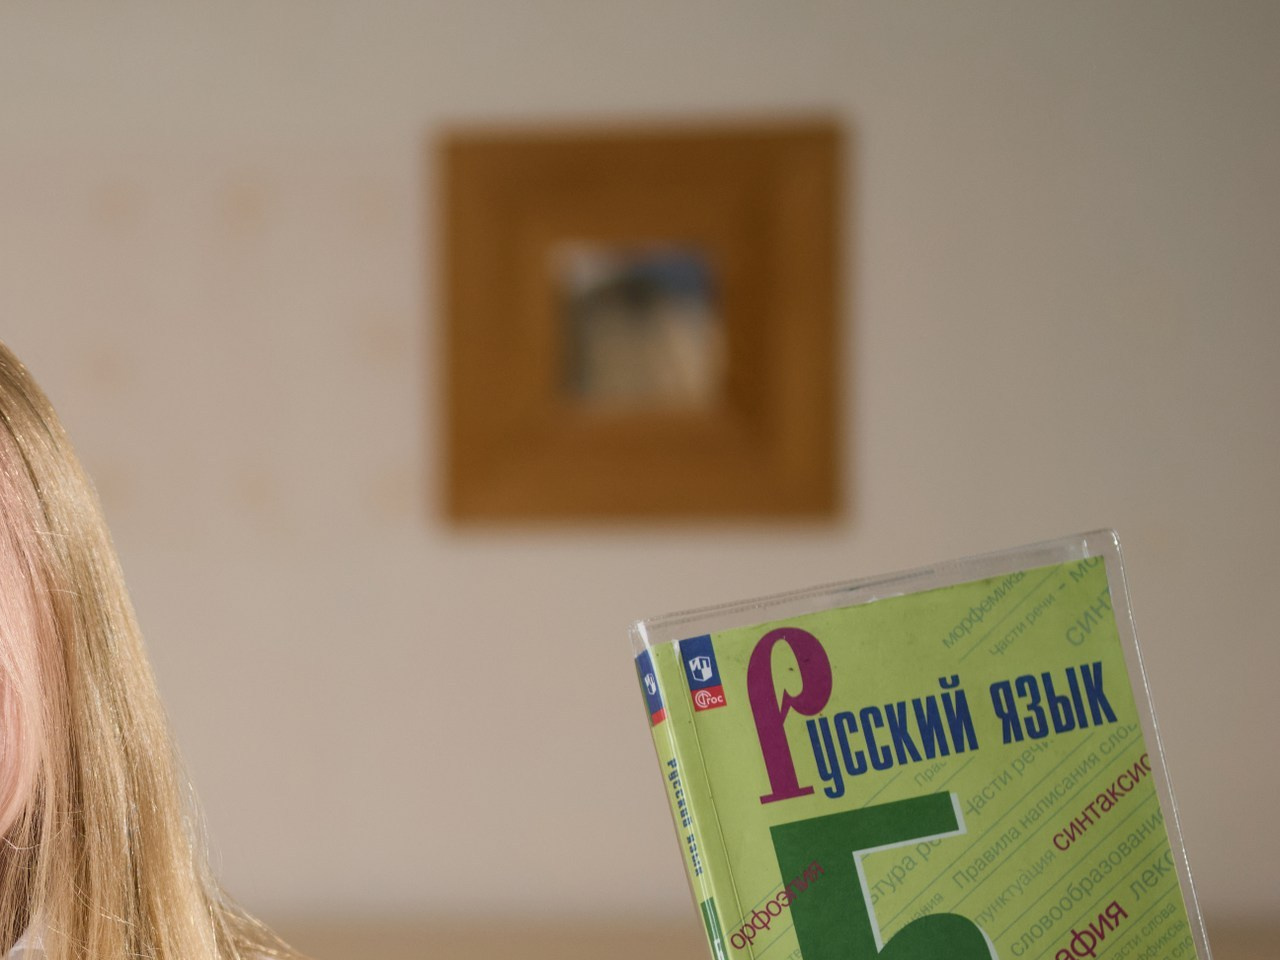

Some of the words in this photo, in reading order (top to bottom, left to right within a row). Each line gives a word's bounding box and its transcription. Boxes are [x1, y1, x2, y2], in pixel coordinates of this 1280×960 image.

[942, 570, 1025, 649] морфемика
[1025, 593, 1056, 626] речи
[747, 627, 979, 804] Русский
[952, 827, 1021, 889] Правила
[1019, 751, 1101, 831] написания
[730, 860, 825, 950] орфоэпия
[974, 849, 1057, 928] пунктуация
[1141, 902, 1177, 938] слова
